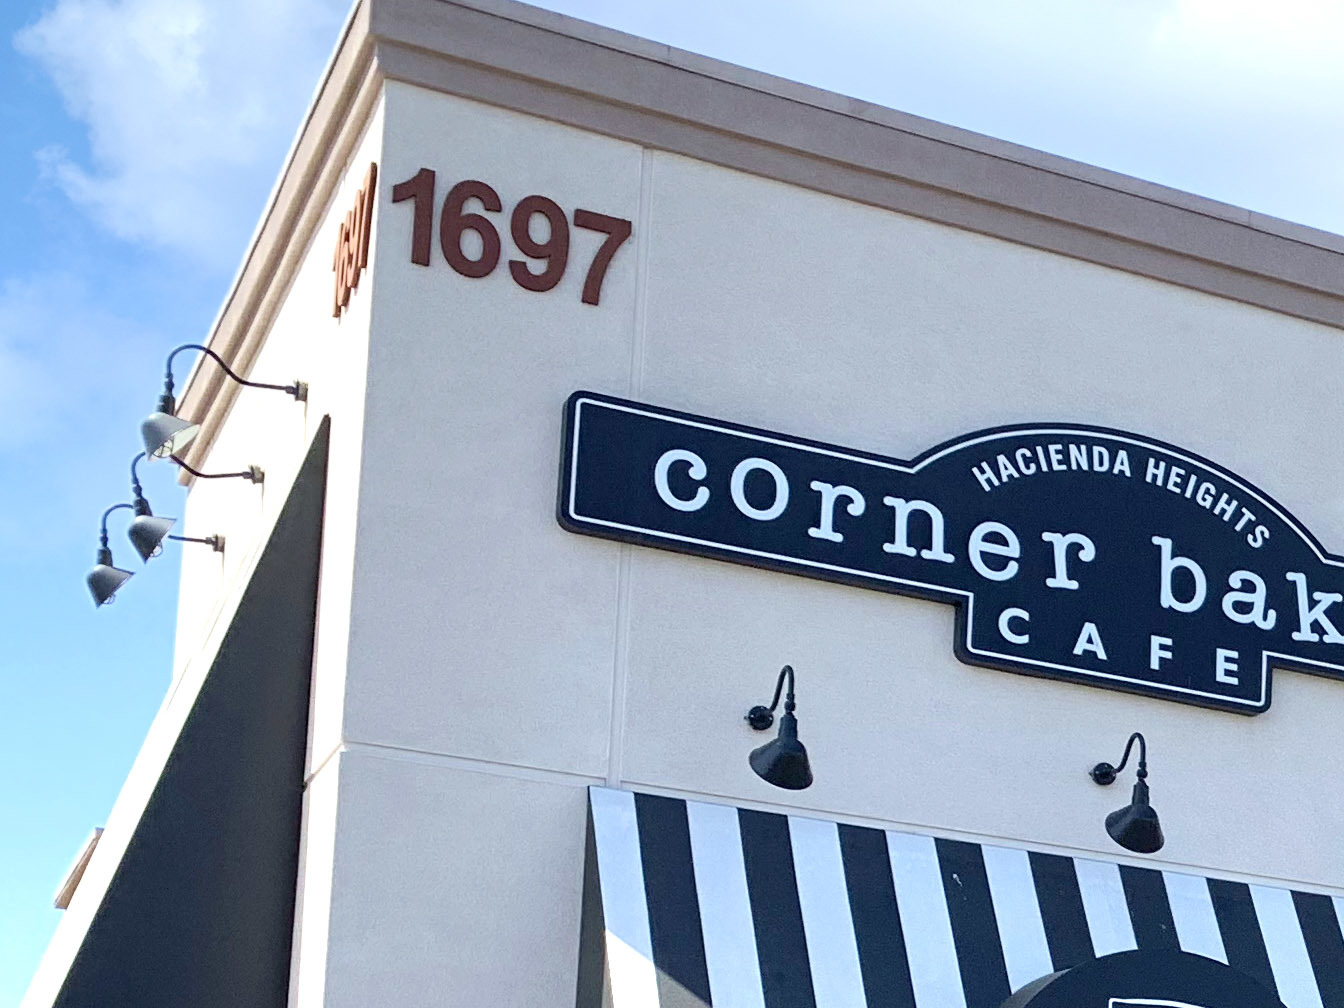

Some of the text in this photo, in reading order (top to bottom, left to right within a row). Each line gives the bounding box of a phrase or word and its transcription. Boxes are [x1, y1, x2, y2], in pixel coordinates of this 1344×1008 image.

[392, 167, 632, 306] 1697
[654, 449, 1096, 590] corner
[971, 443, 1271, 549] HACIENDA HEIGHTS
[997, 607, 1240, 685] CAFE
